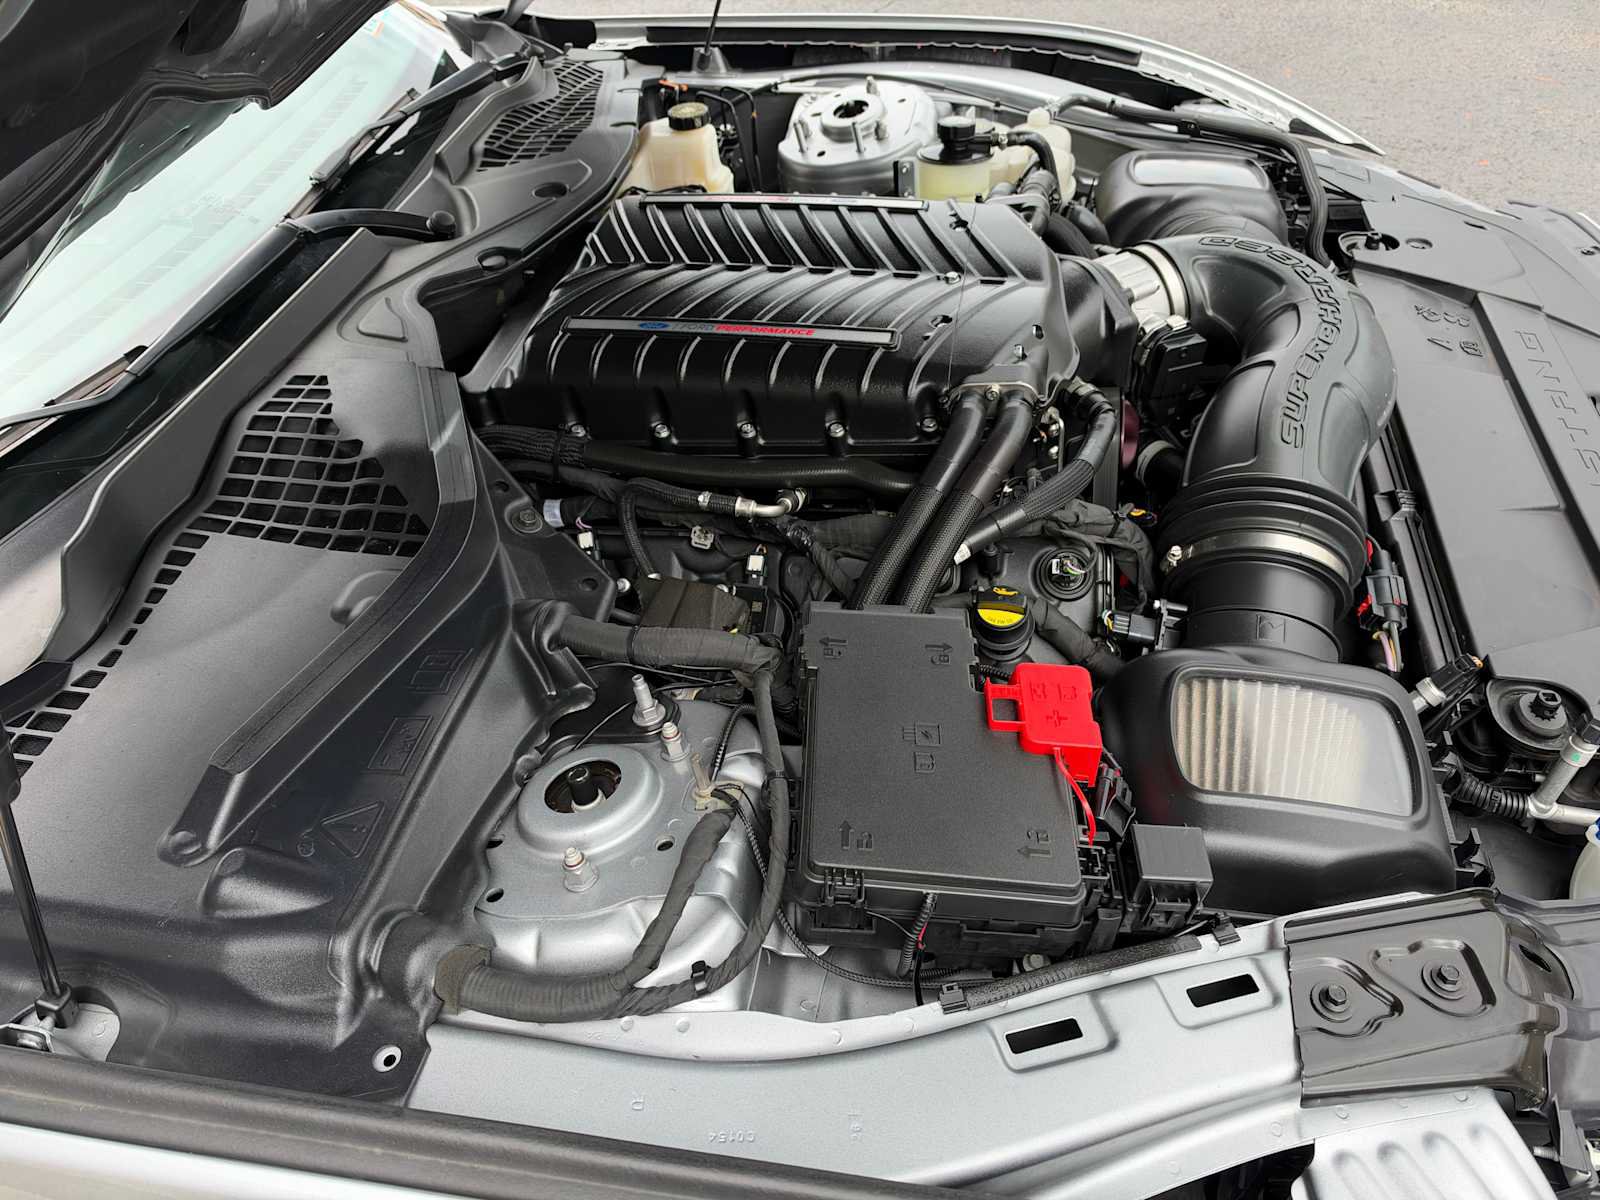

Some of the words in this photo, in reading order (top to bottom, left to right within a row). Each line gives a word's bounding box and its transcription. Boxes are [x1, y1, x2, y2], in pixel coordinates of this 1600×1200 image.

[714, 323, 816, 336] PERFORMANCE
[1199, 236, 1343, 448] SUPERCHARGED
[1515, 330, 1600, 486] STANG
